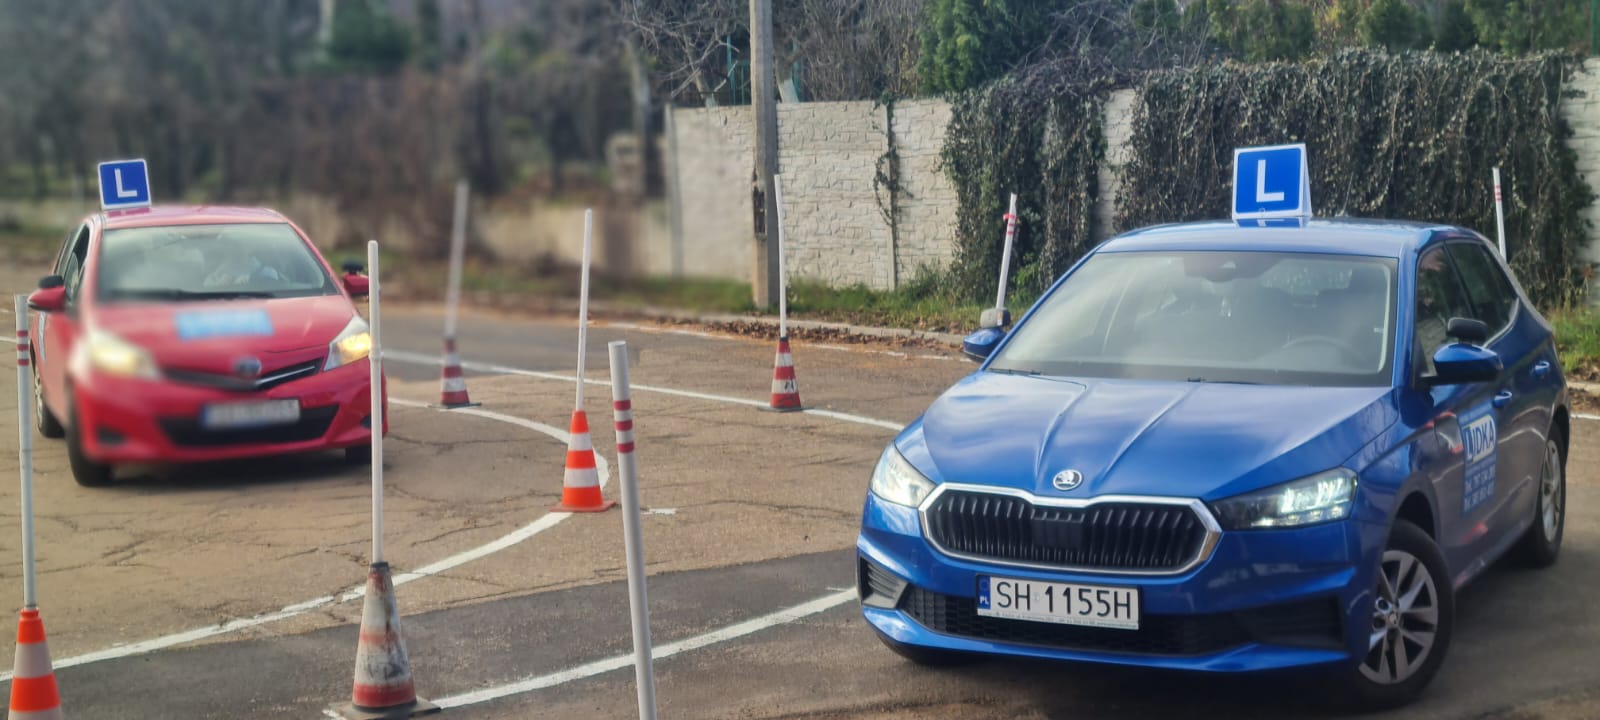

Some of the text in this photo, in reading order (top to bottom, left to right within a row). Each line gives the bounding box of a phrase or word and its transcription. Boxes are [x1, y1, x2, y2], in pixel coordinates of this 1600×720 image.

[114, 168, 138, 198] L
[1256, 159, 1285, 203] L
[1463, 420, 1495, 460] LIDKA
[979, 596, 990, 605] PL
[996, 581, 1131, 619] SH 1155H
